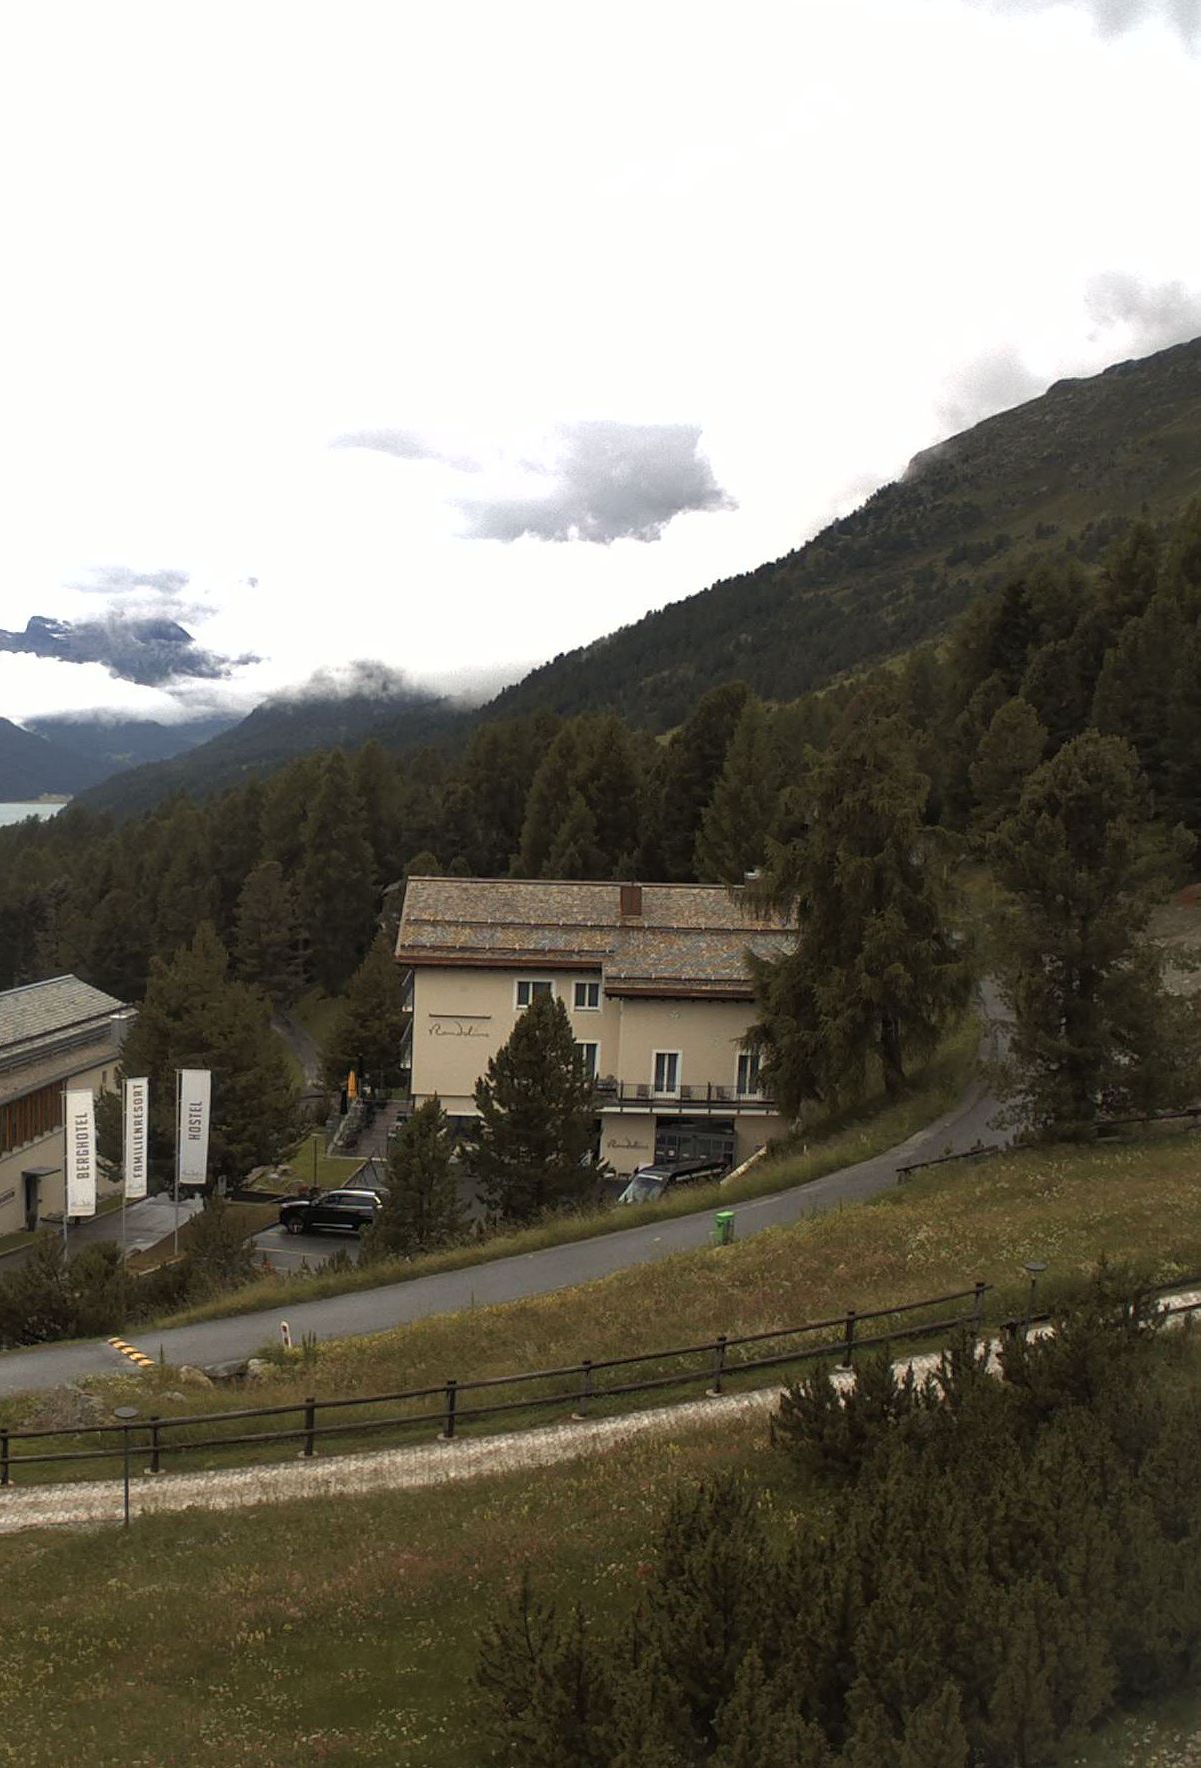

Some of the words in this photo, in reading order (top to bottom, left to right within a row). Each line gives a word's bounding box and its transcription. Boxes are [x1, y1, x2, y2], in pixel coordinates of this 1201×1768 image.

[75, 1112, 90, 1180] BERGHOTEL
[133, 1084, 144, 1179] FAMILIENRESORT
[188, 1101, 203, 1141] HOSTEL
